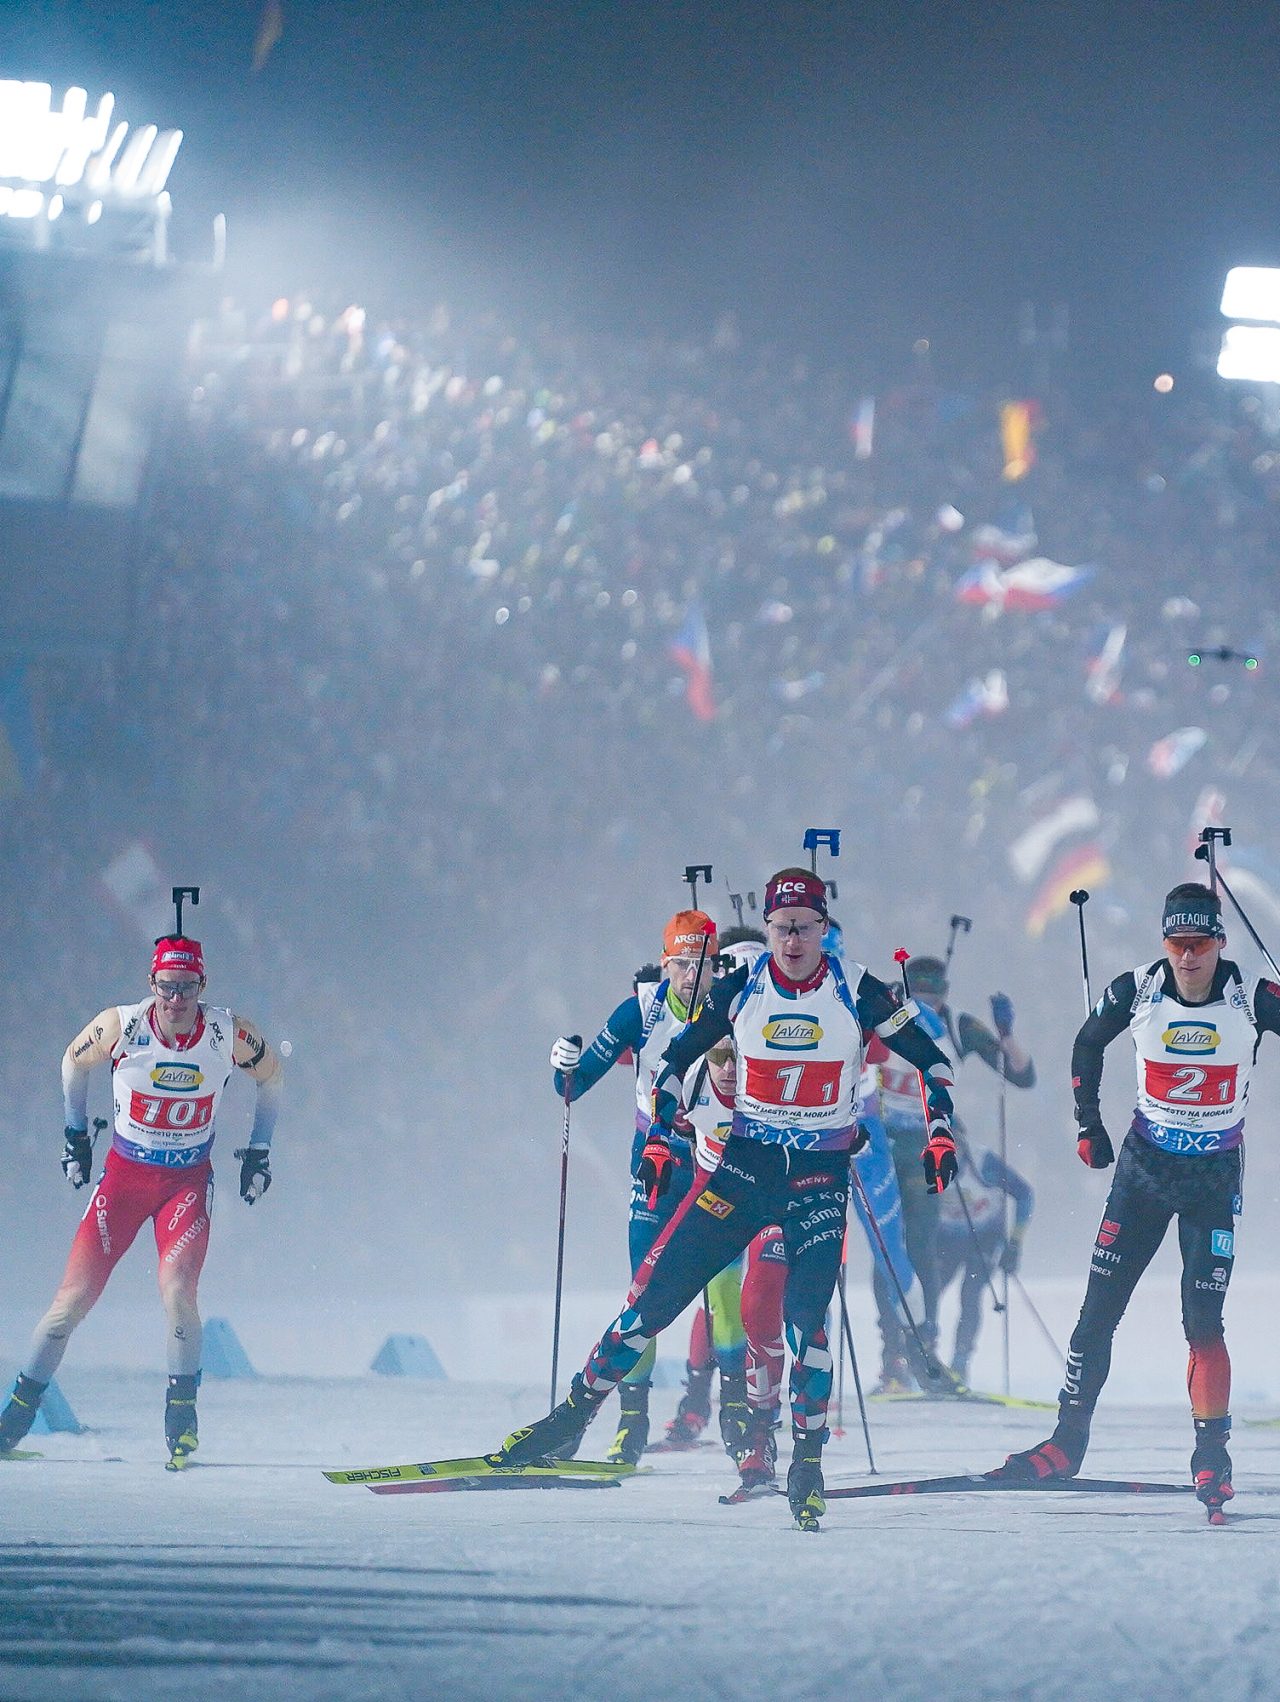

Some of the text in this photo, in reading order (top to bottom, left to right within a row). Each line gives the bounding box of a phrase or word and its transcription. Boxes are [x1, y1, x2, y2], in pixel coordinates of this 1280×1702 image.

[775, 881, 806, 894] ice
[1132, 974, 1151, 1013] robotron
[1236, 984, 1255, 1023] robotron
[124, 1018, 138, 1038] JOKA
[641, 999, 663, 1038] Lumar
[210, 1021, 224, 1042] JOKA
[777, 1064, 806, 1102] 1
[822, 1081, 833, 1102] 1
[1167, 1067, 1207, 1101] 2
[1218, 1079, 1231, 1101] 1
[141, 1098, 197, 1127] 10
[789, 1108, 802, 1117] NA
[1188, 1108, 1201, 1118] NA
[778, 1129, 820, 1151] iX2
[1176, 1132, 1220, 1152] iX2
[721, 1160, 756, 1184] LAPUA
[796, 1175, 829, 1188] MENY
[635, 1192, 648, 1202] NL
[787, 1191, 845, 1212] ASKO
[96, 1209, 111, 1254] Sunrise
[796, 1230, 838, 1256] CRAFT
[1093, 1247, 1121, 1264] RTH
[1195, 1279, 1228, 1292] tecta
[346, 1466, 402, 1482] FISCHER
